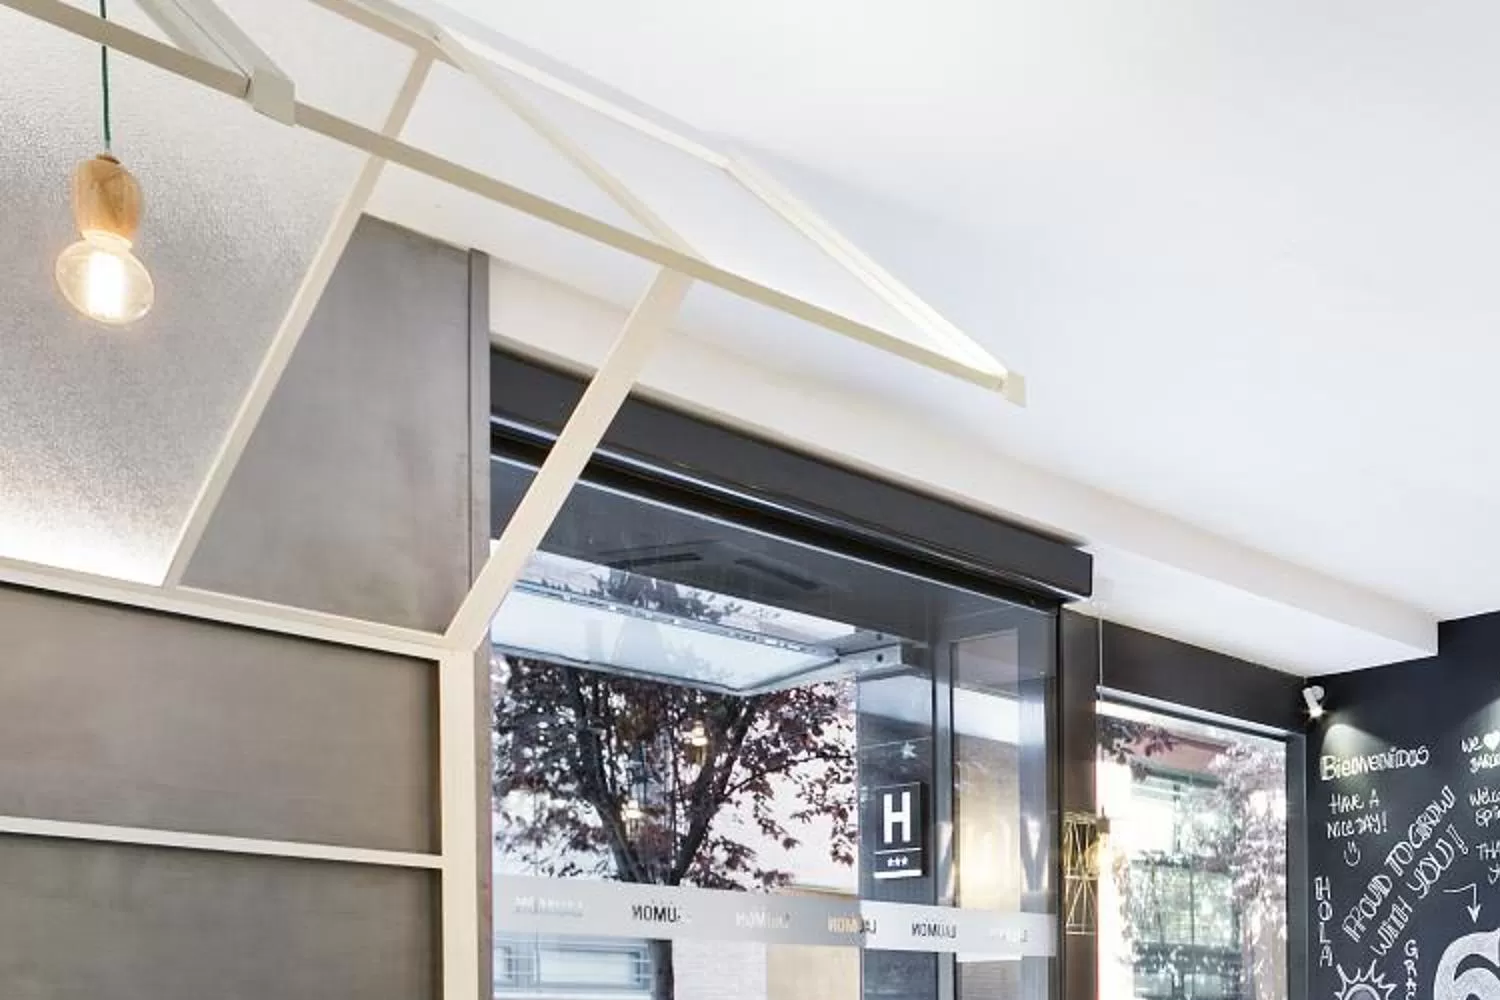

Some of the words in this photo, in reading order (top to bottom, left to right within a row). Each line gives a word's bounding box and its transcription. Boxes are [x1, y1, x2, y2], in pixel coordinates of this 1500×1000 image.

[883, 791, 911, 844] H
[1384, 841, 1413, 876] TO
[1314, 875, 1333, 968] HOLA
